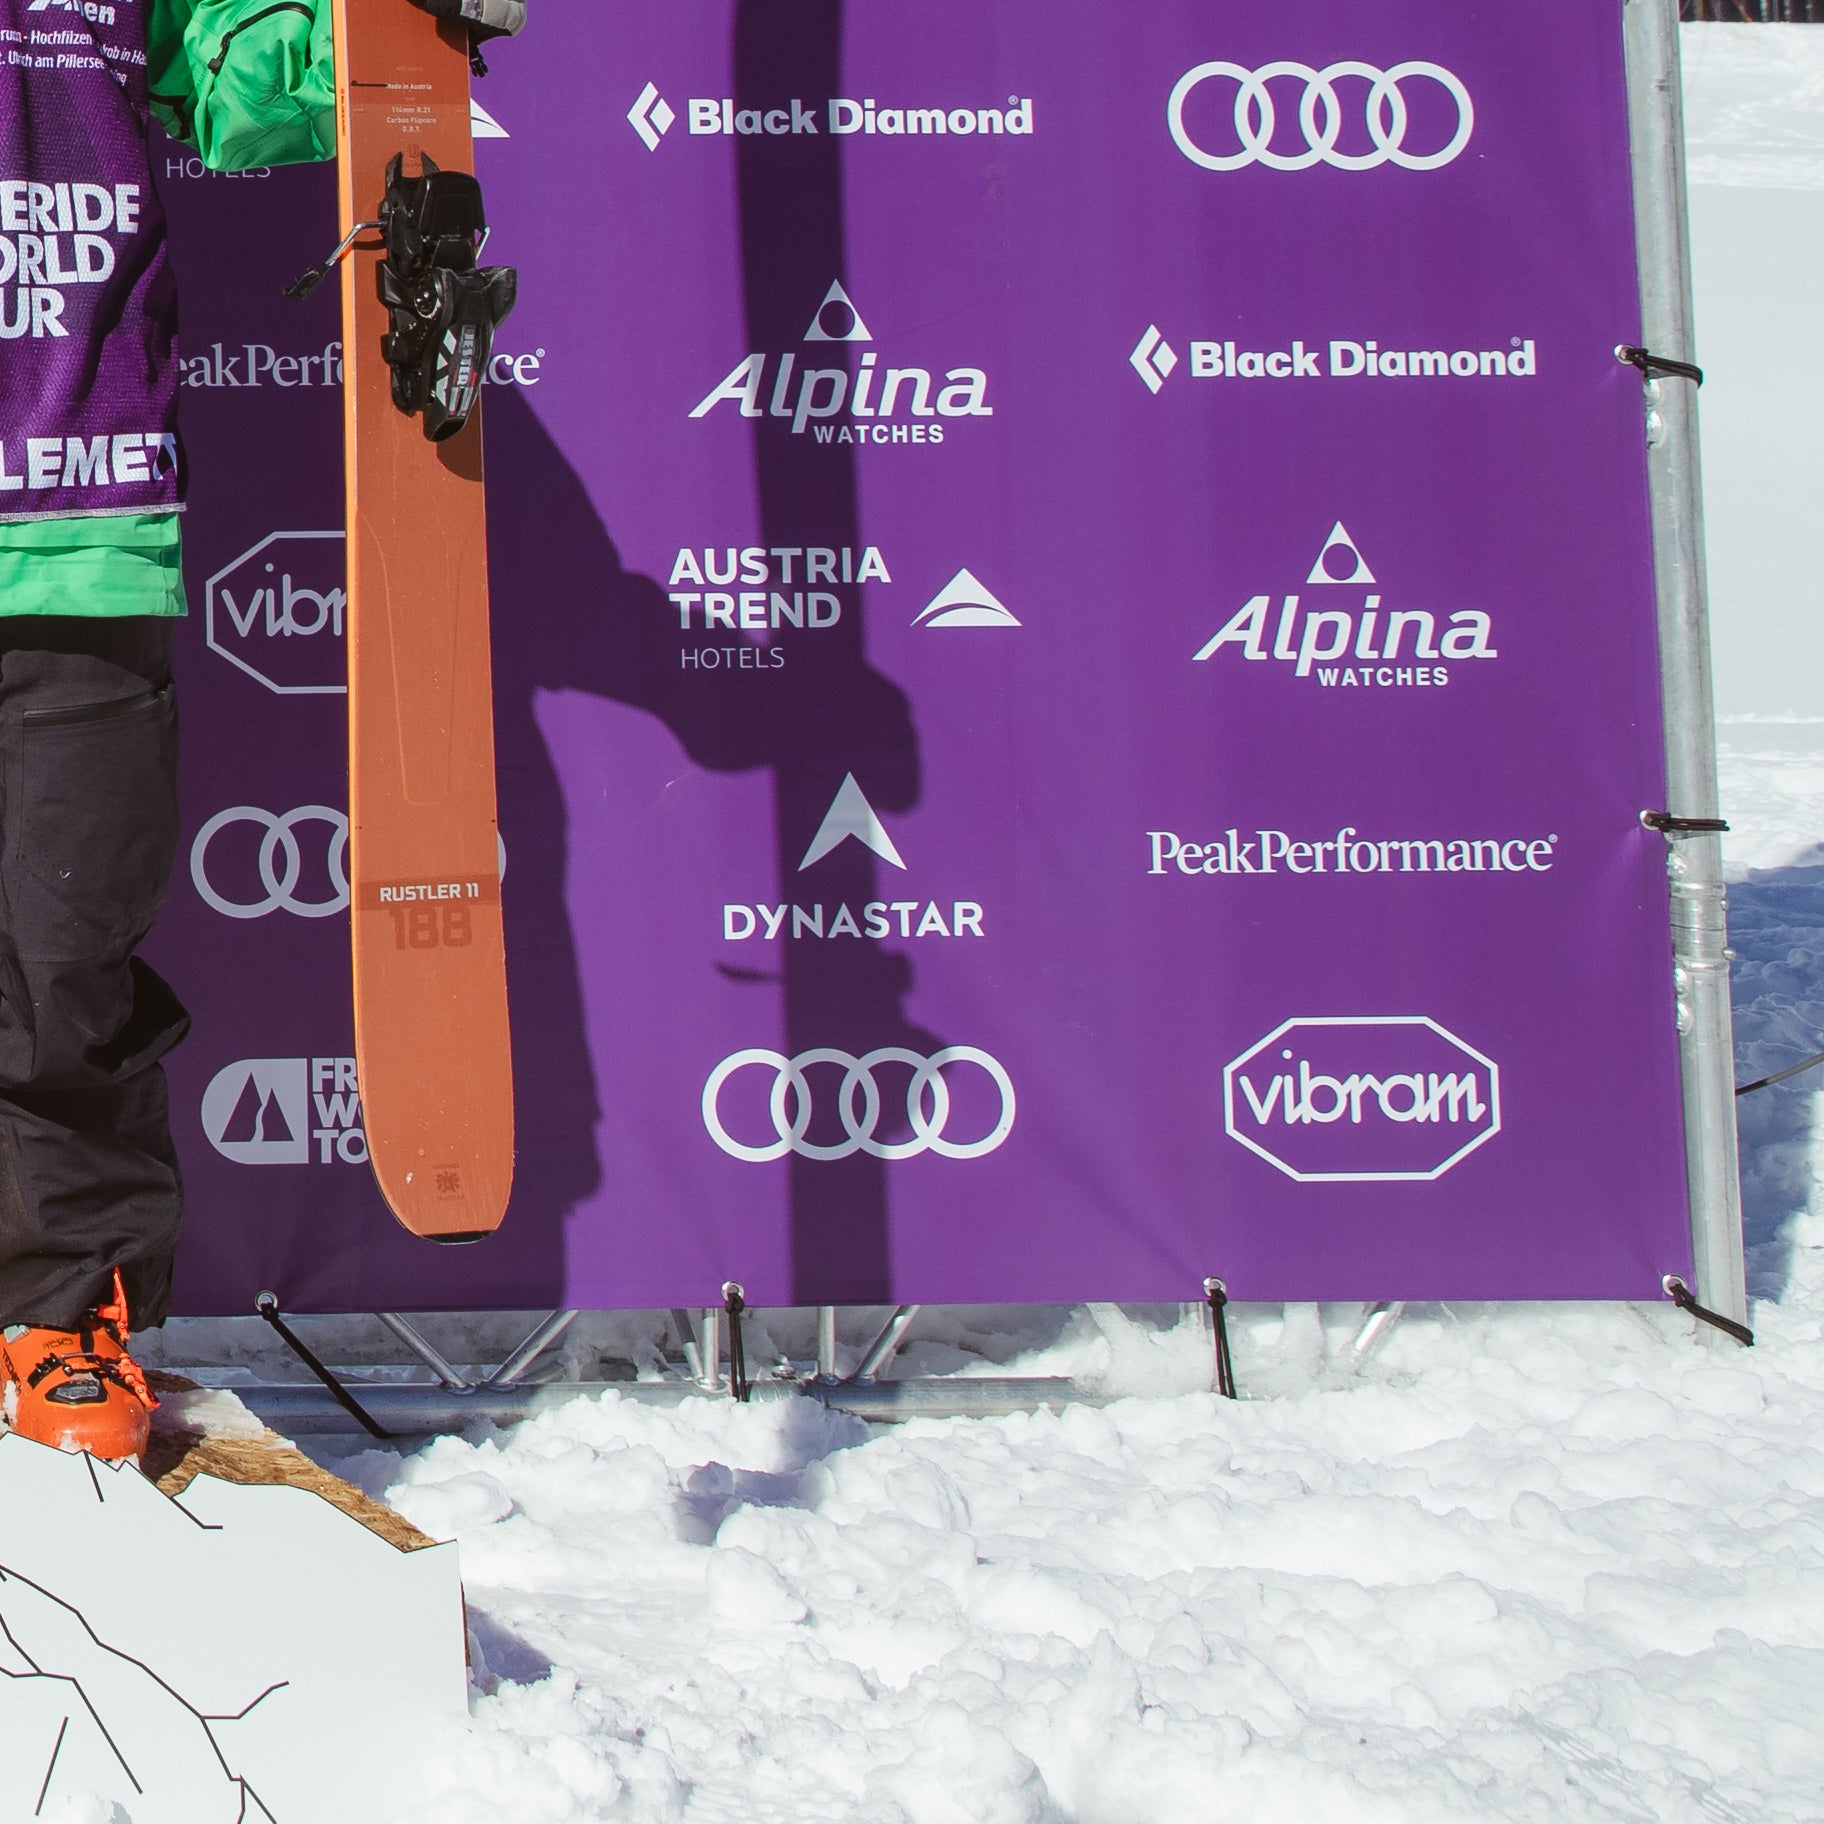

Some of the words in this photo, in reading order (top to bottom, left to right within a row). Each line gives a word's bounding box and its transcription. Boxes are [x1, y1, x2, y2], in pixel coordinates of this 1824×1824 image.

[688, 99, 817, 134] Black
[830, 96, 1033, 134] Diamond
[1191, 341, 1320, 377] Black
[1330, 338, 1535, 376] Diamond
[687, 353, 994, 434] Alpina
[814, 424, 943, 443] WATCHES
[668, 546, 892, 585] AUSTRIA
[668, 592, 842, 629] TREND
[1193, 595, 1497, 678] Alpina
[1317, 667, 1448, 686] WATCHES
[379, 883, 461, 902] RUSTLER
[466, 882, 479, 899] 11
[389, 905, 472, 950] 188
[724, 900, 985, 941] DYNASTAR
[1238, 1049, 1485, 1124] vibram
